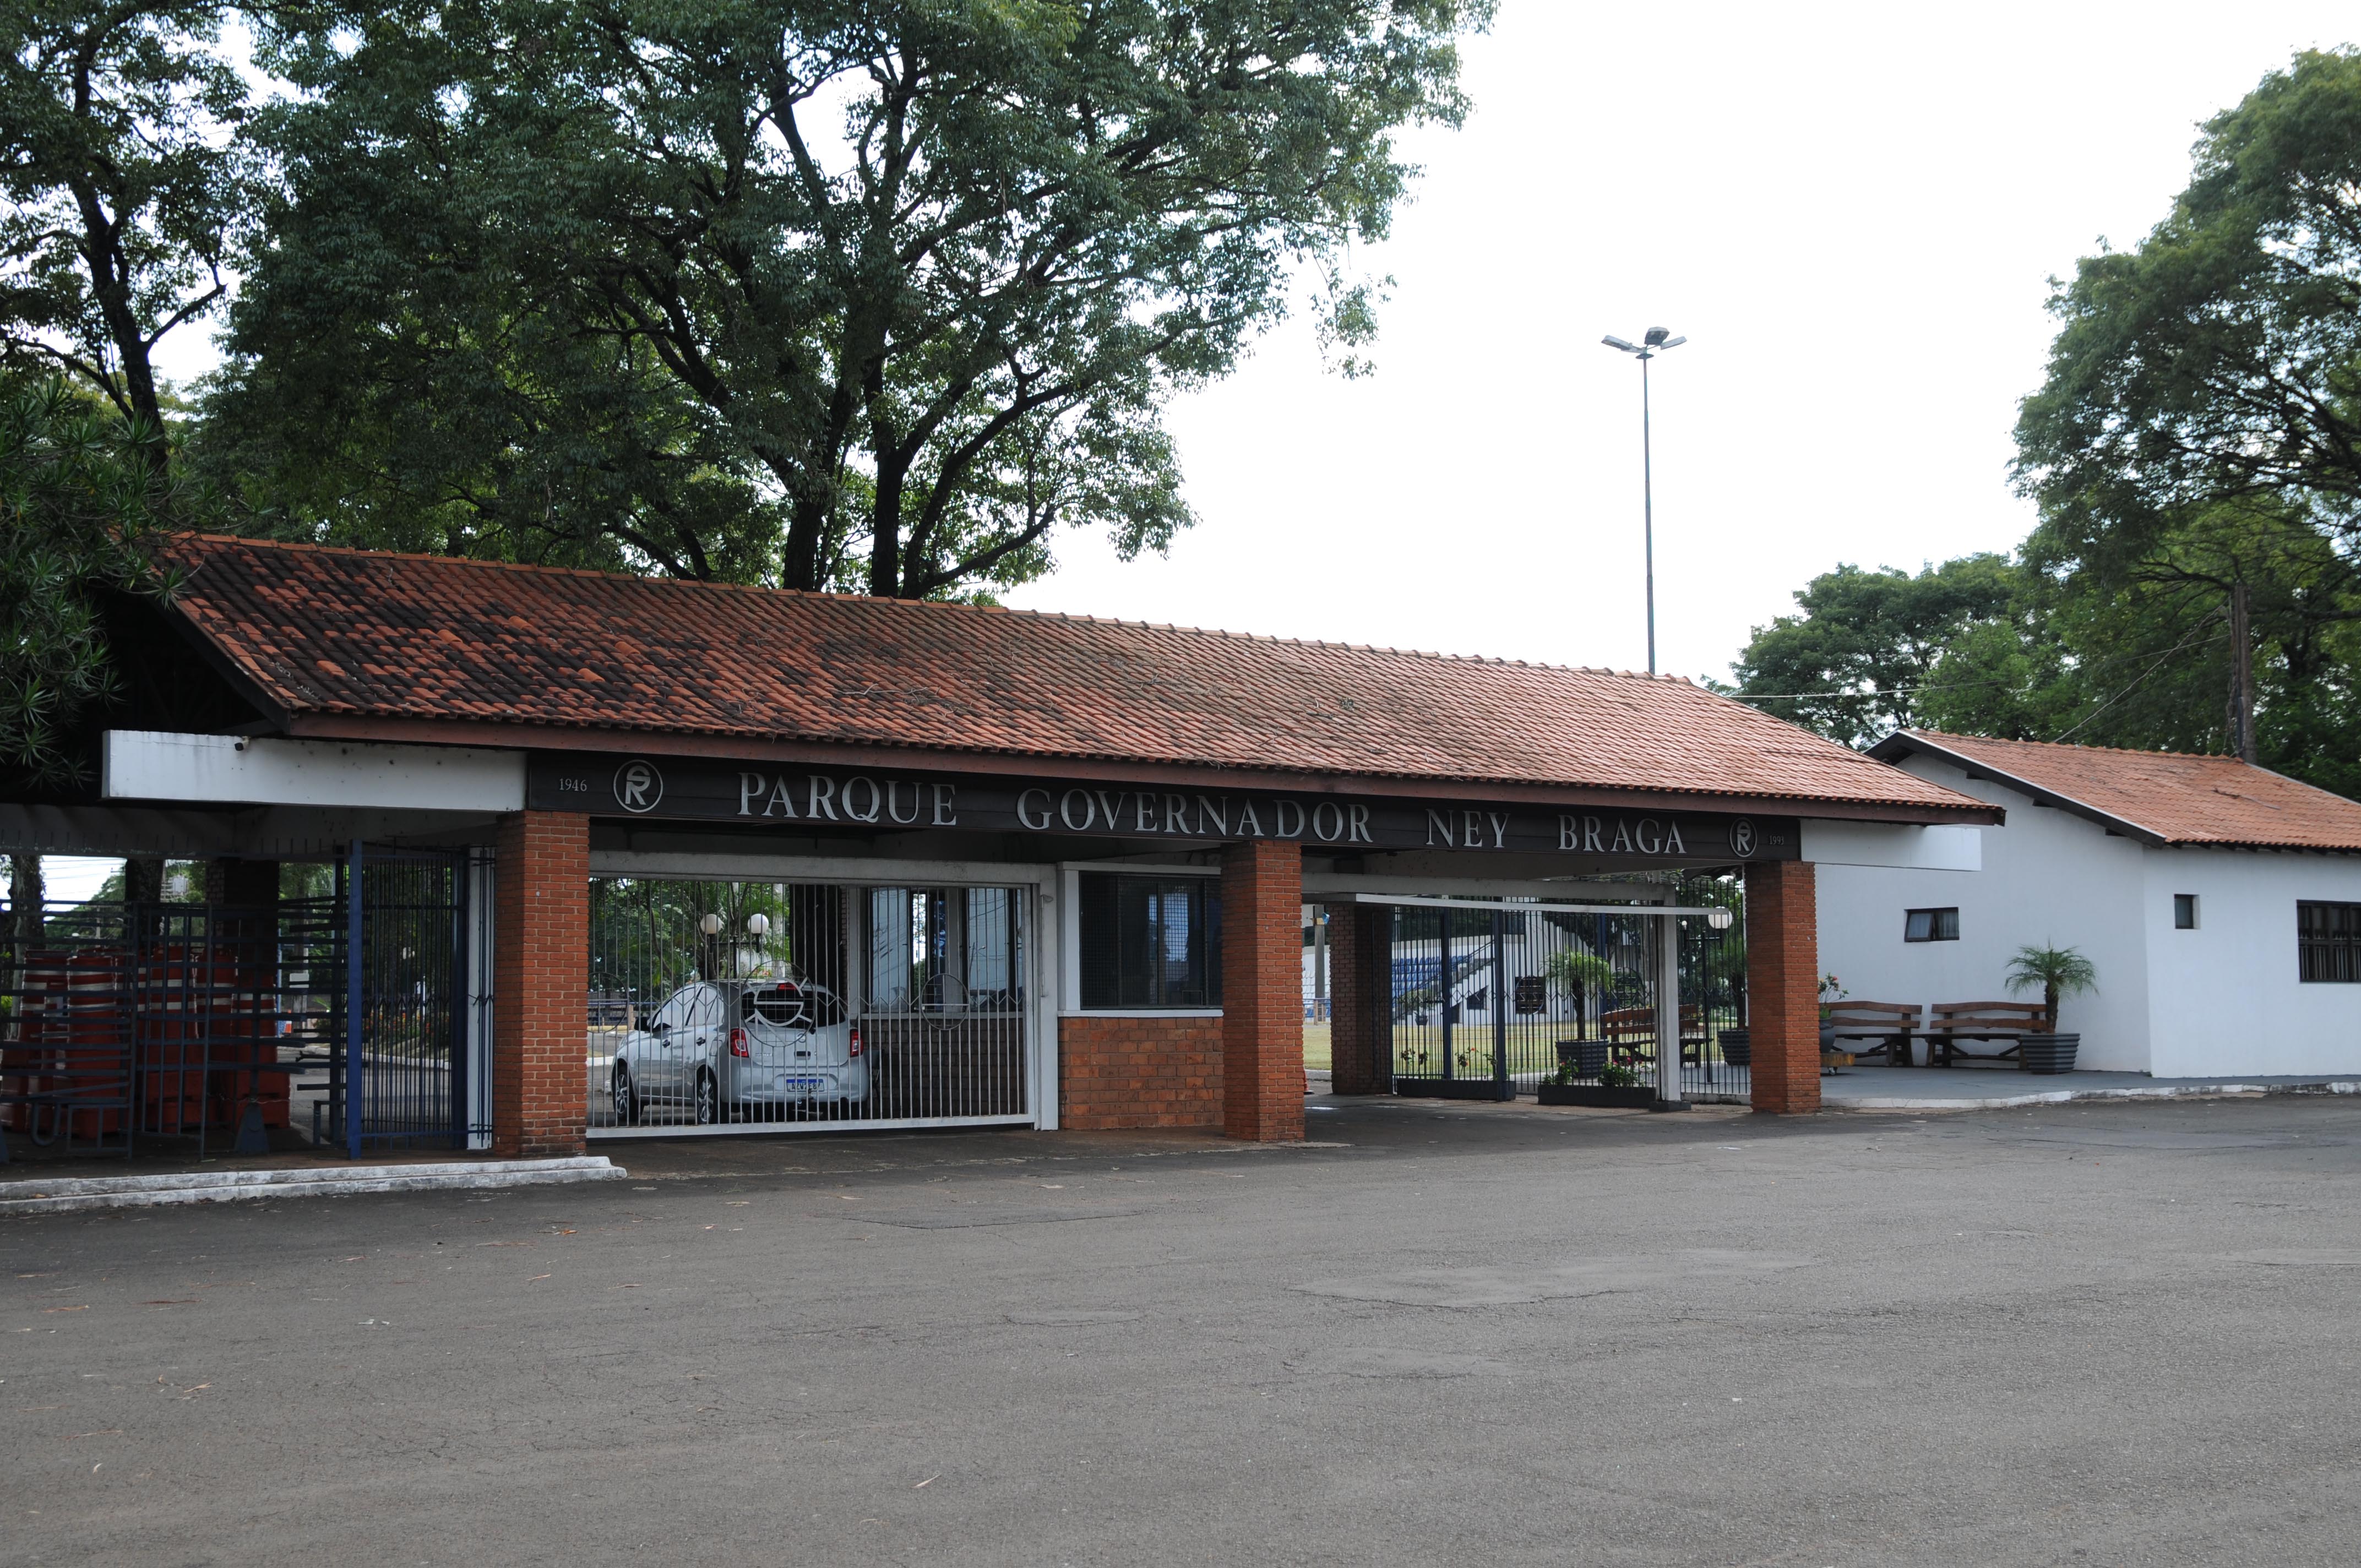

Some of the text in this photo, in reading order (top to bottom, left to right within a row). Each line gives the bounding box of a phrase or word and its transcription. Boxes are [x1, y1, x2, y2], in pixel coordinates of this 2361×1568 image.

[559, 778, 587, 792] 1946
[737, 772, 1687, 854] PARQUE GOVERNADOR NEY BRAGA
